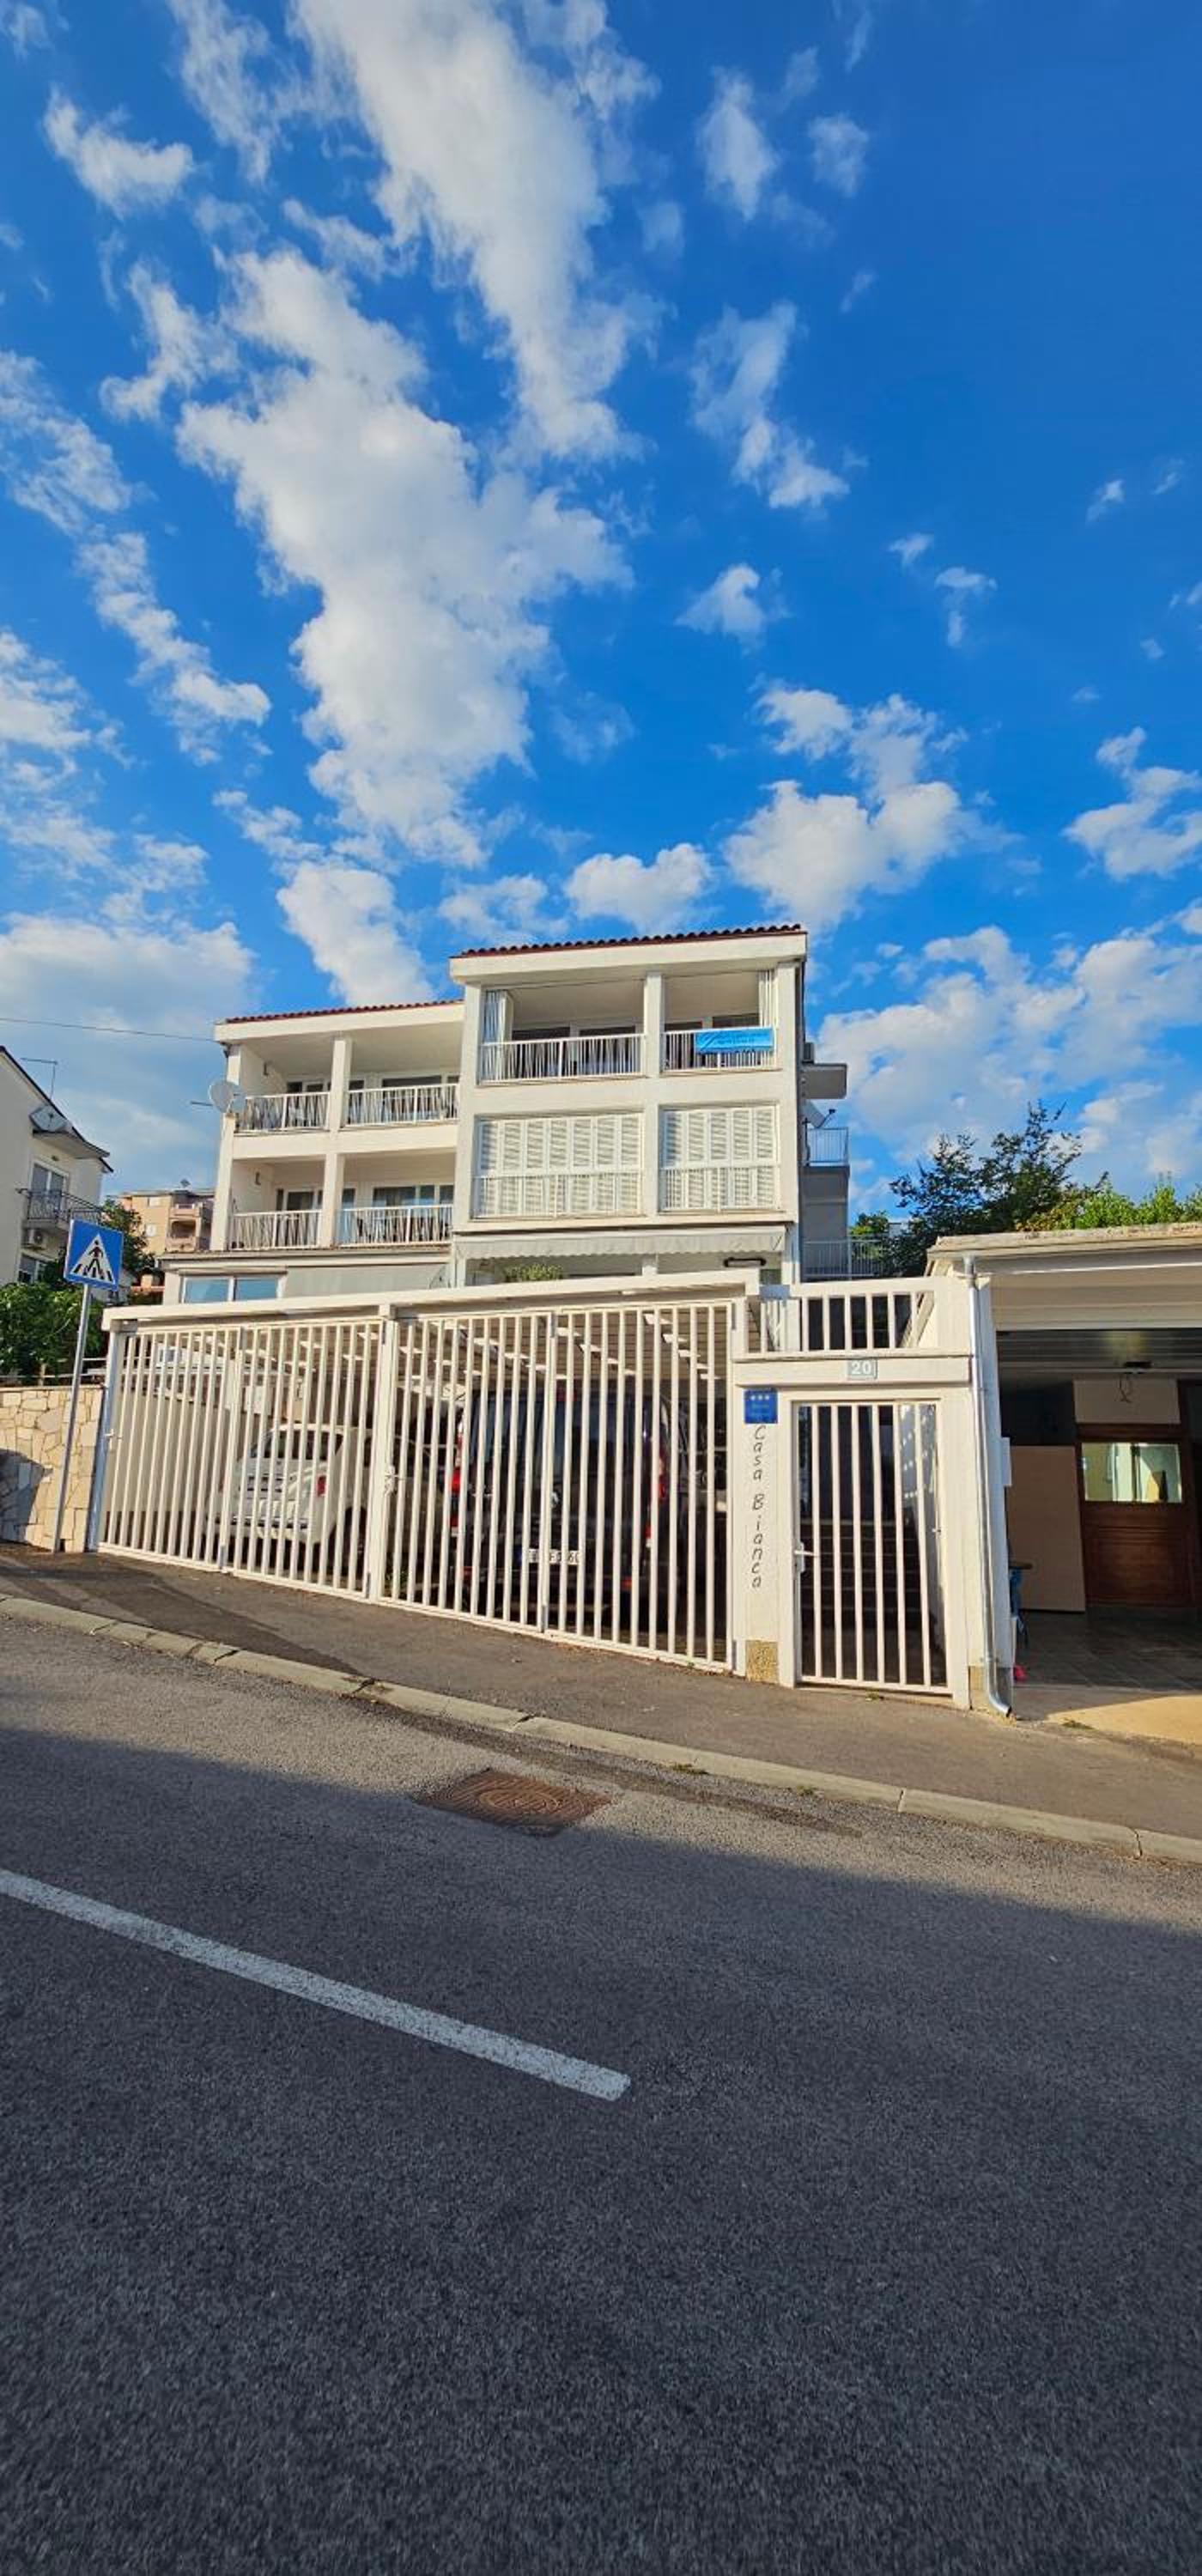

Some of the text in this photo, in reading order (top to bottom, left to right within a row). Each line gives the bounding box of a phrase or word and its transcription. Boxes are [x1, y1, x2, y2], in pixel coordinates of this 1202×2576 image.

[851, 1360, 871, 1375] 20
[752, 1425, 767, 1481] Casa
[751, 1493, 766, 1589] Bianca
